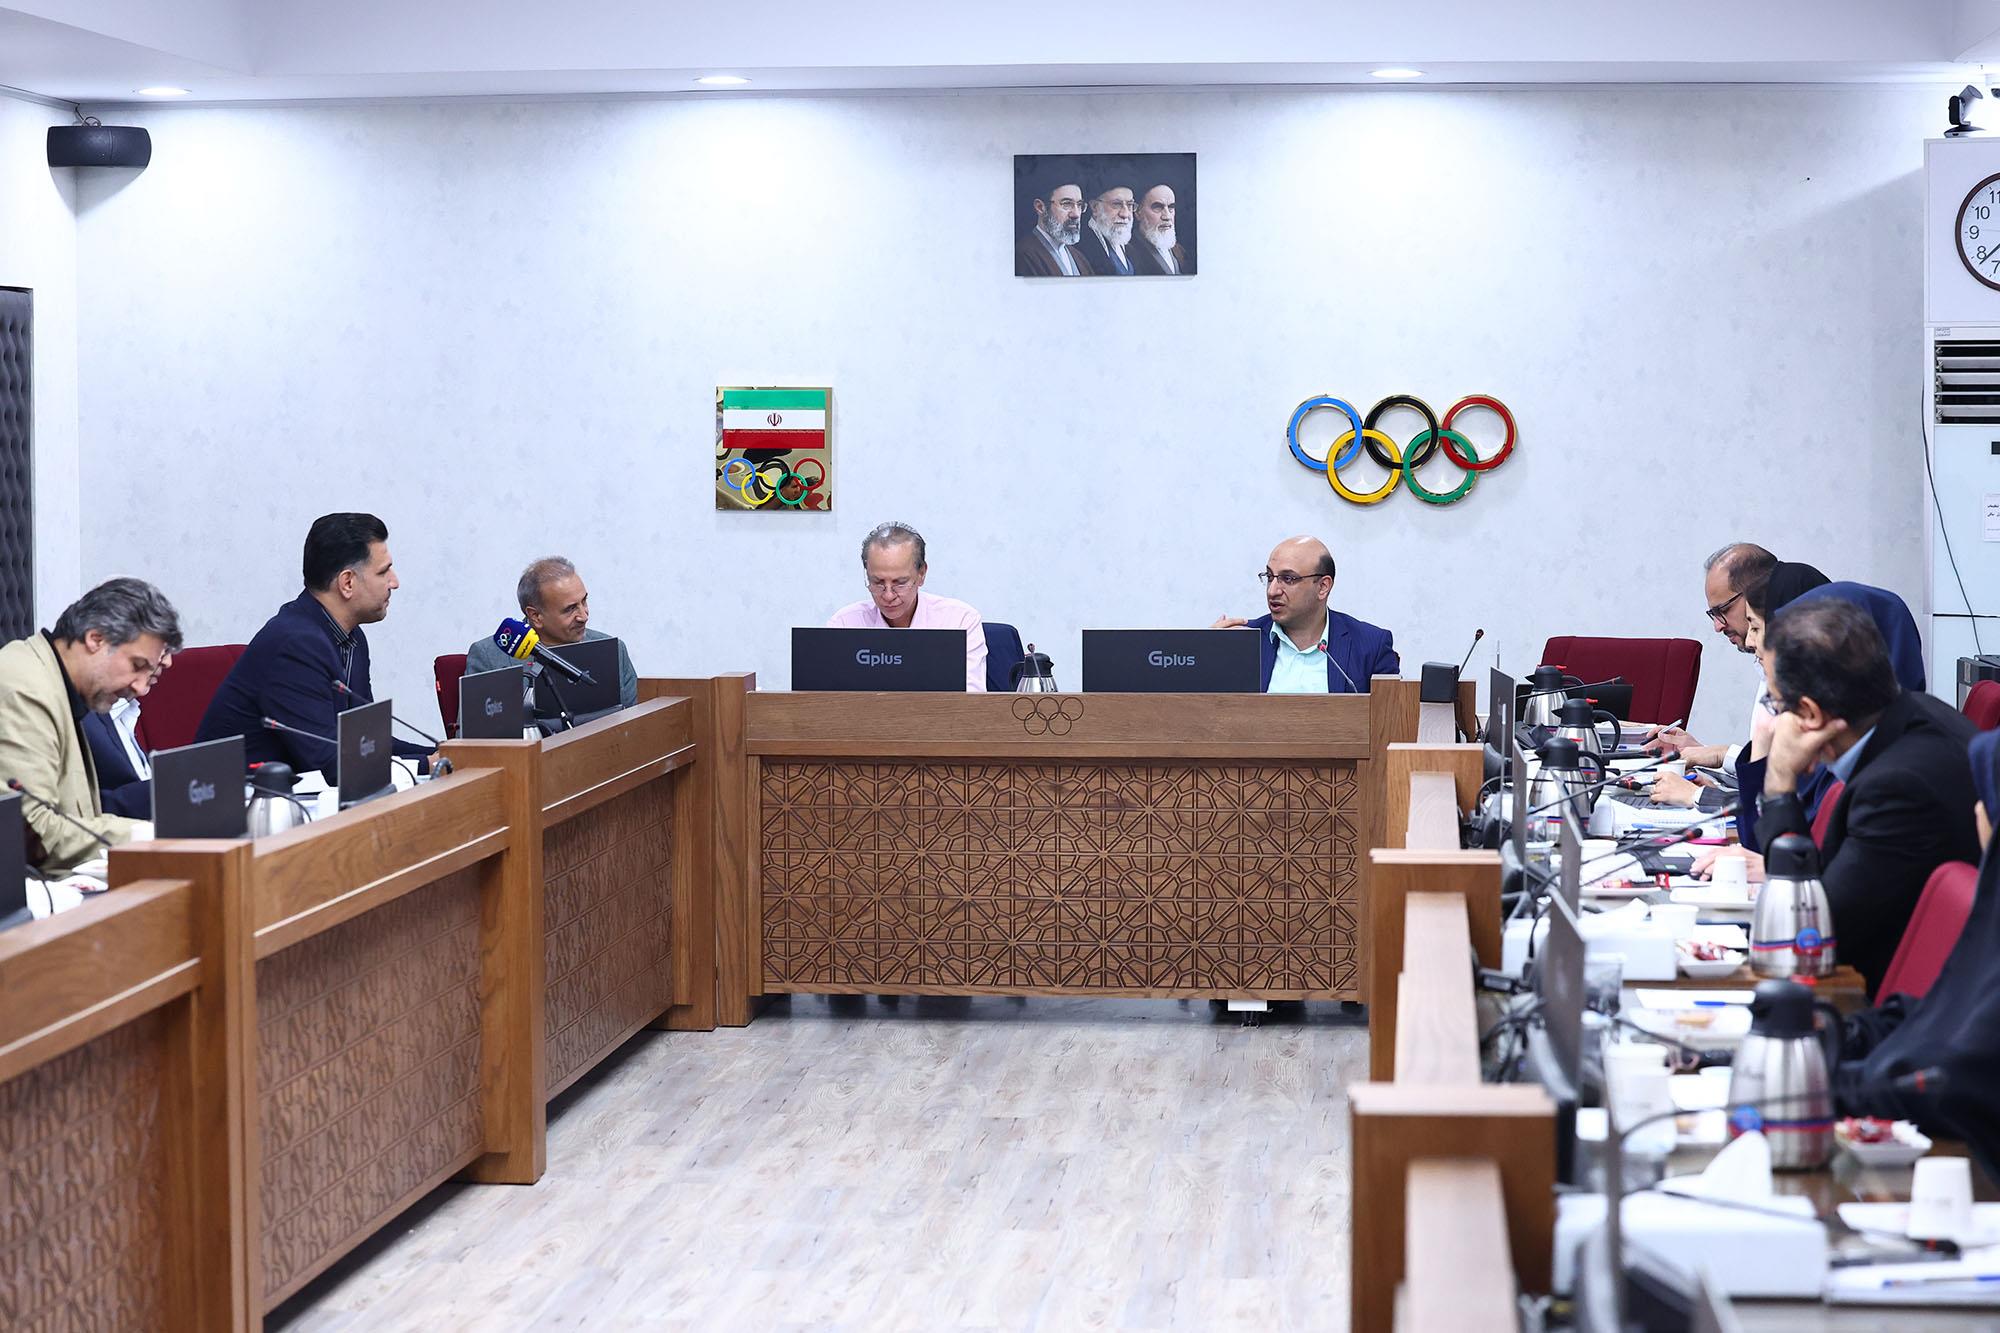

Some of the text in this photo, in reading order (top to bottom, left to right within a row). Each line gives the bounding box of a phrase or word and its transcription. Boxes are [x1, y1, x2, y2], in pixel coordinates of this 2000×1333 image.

[1974, 206, 1990, 220] 10
[1969, 225, 1980, 240] 9
[1976, 245, 1987, 260] 8
[1991, 260, 2000, 274] 7
[855, 650, 903, 667] Gplus
[1148, 650, 1196, 667] Gplus
